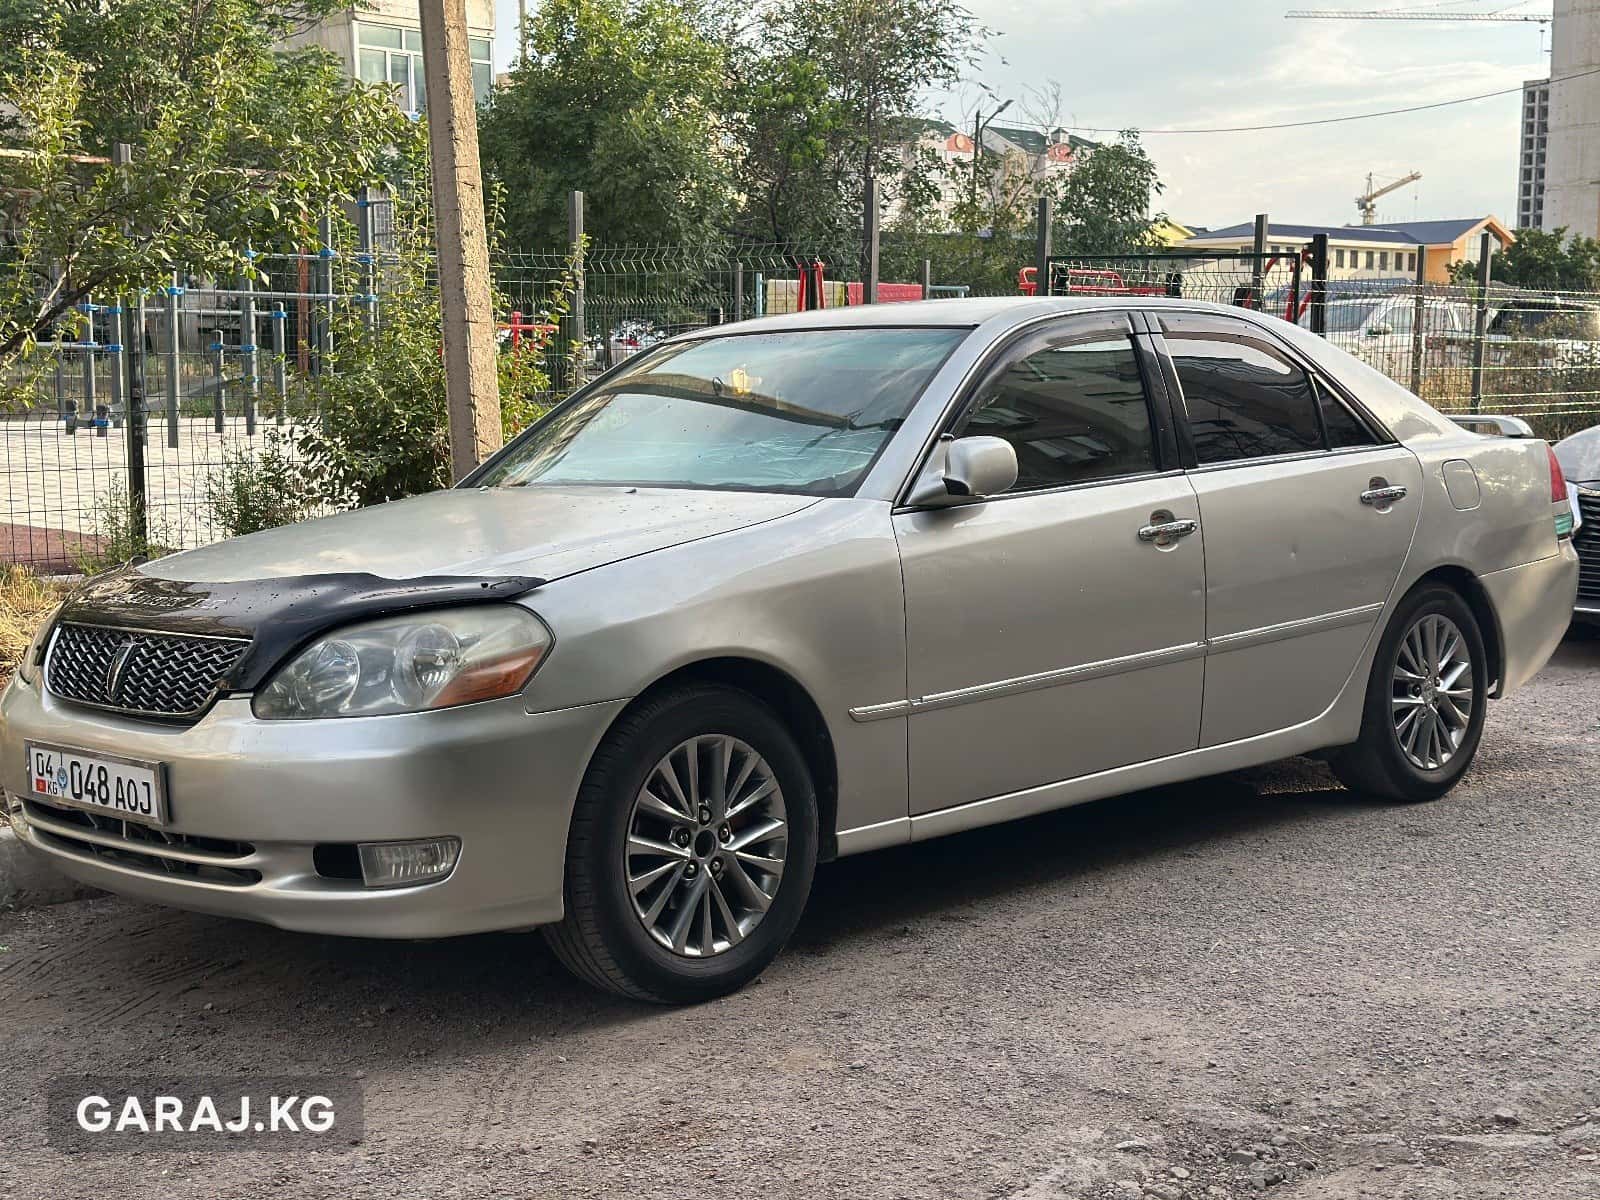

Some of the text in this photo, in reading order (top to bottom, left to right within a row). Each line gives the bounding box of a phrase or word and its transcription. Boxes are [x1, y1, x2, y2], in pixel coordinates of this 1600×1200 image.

[35, 752, 53, 778] 04
[69, 760, 110, 806] 048
[47, 781, 58, 795] KG
